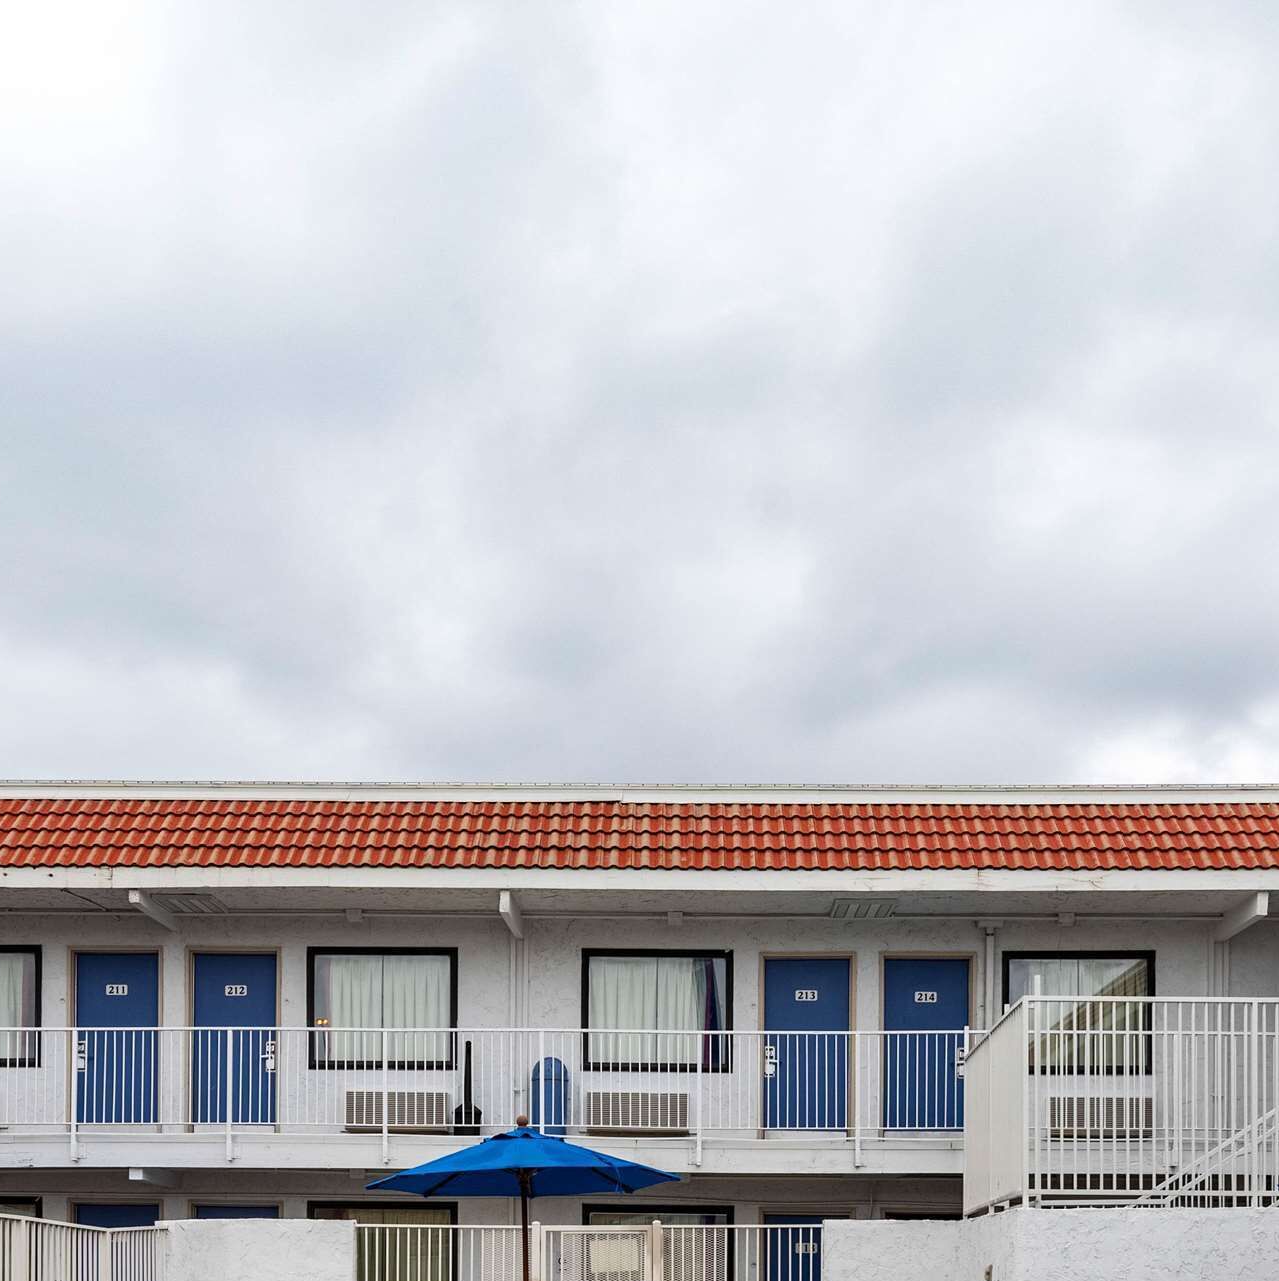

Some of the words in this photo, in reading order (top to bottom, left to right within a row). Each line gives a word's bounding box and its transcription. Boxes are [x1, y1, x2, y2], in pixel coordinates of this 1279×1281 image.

[108, 986, 126, 994] 211
[227, 986, 245, 995] 212
[797, 991, 816, 999] 213
[917, 993, 935, 1001] 214
